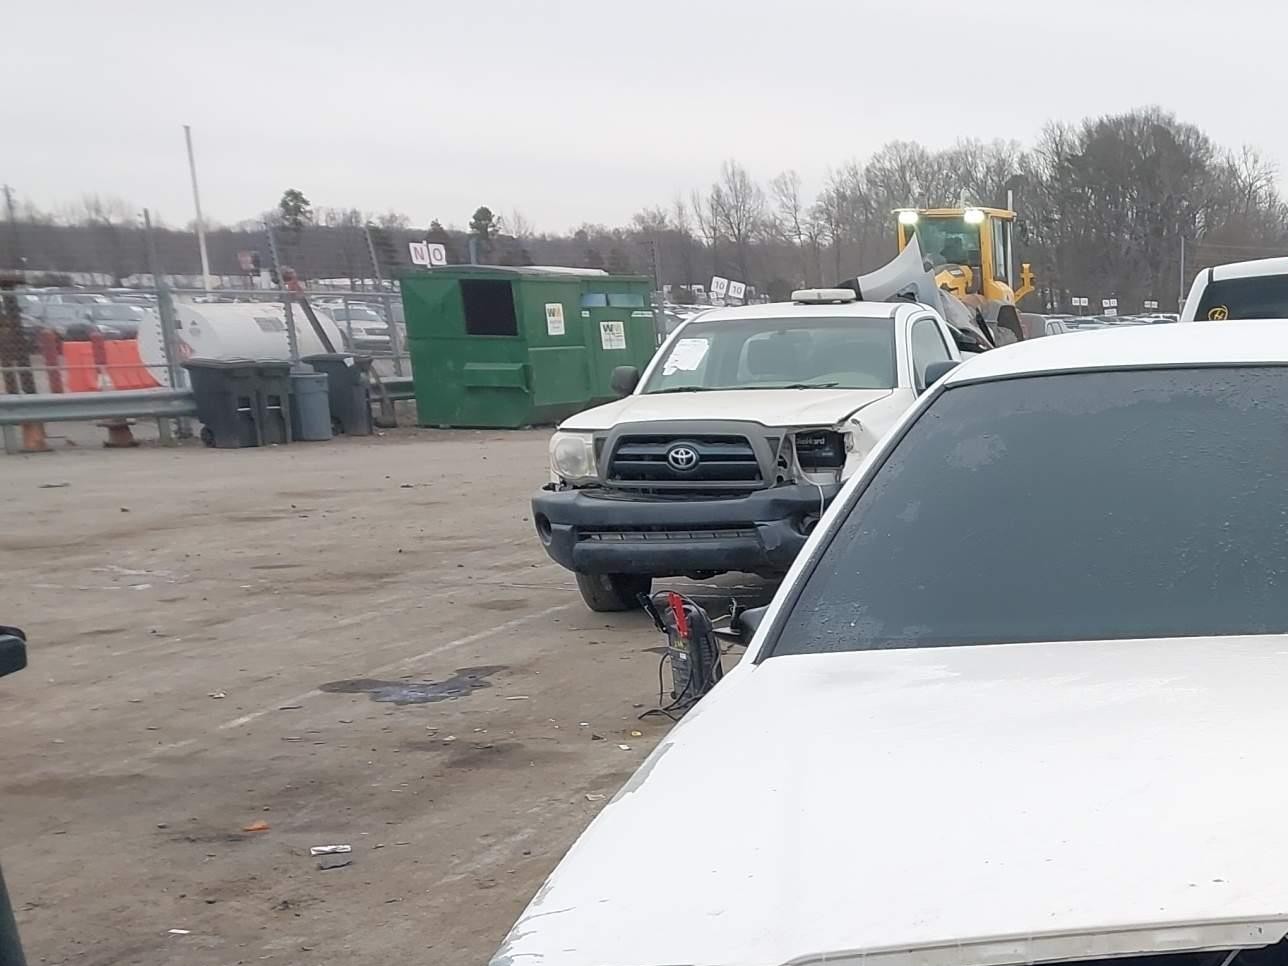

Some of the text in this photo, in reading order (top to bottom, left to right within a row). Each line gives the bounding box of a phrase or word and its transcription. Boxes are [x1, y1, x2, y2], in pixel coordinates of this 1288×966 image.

[413, 246, 425, 260] N
[715, 281, 725, 290] 10
[732, 285, 743, 295] 10
